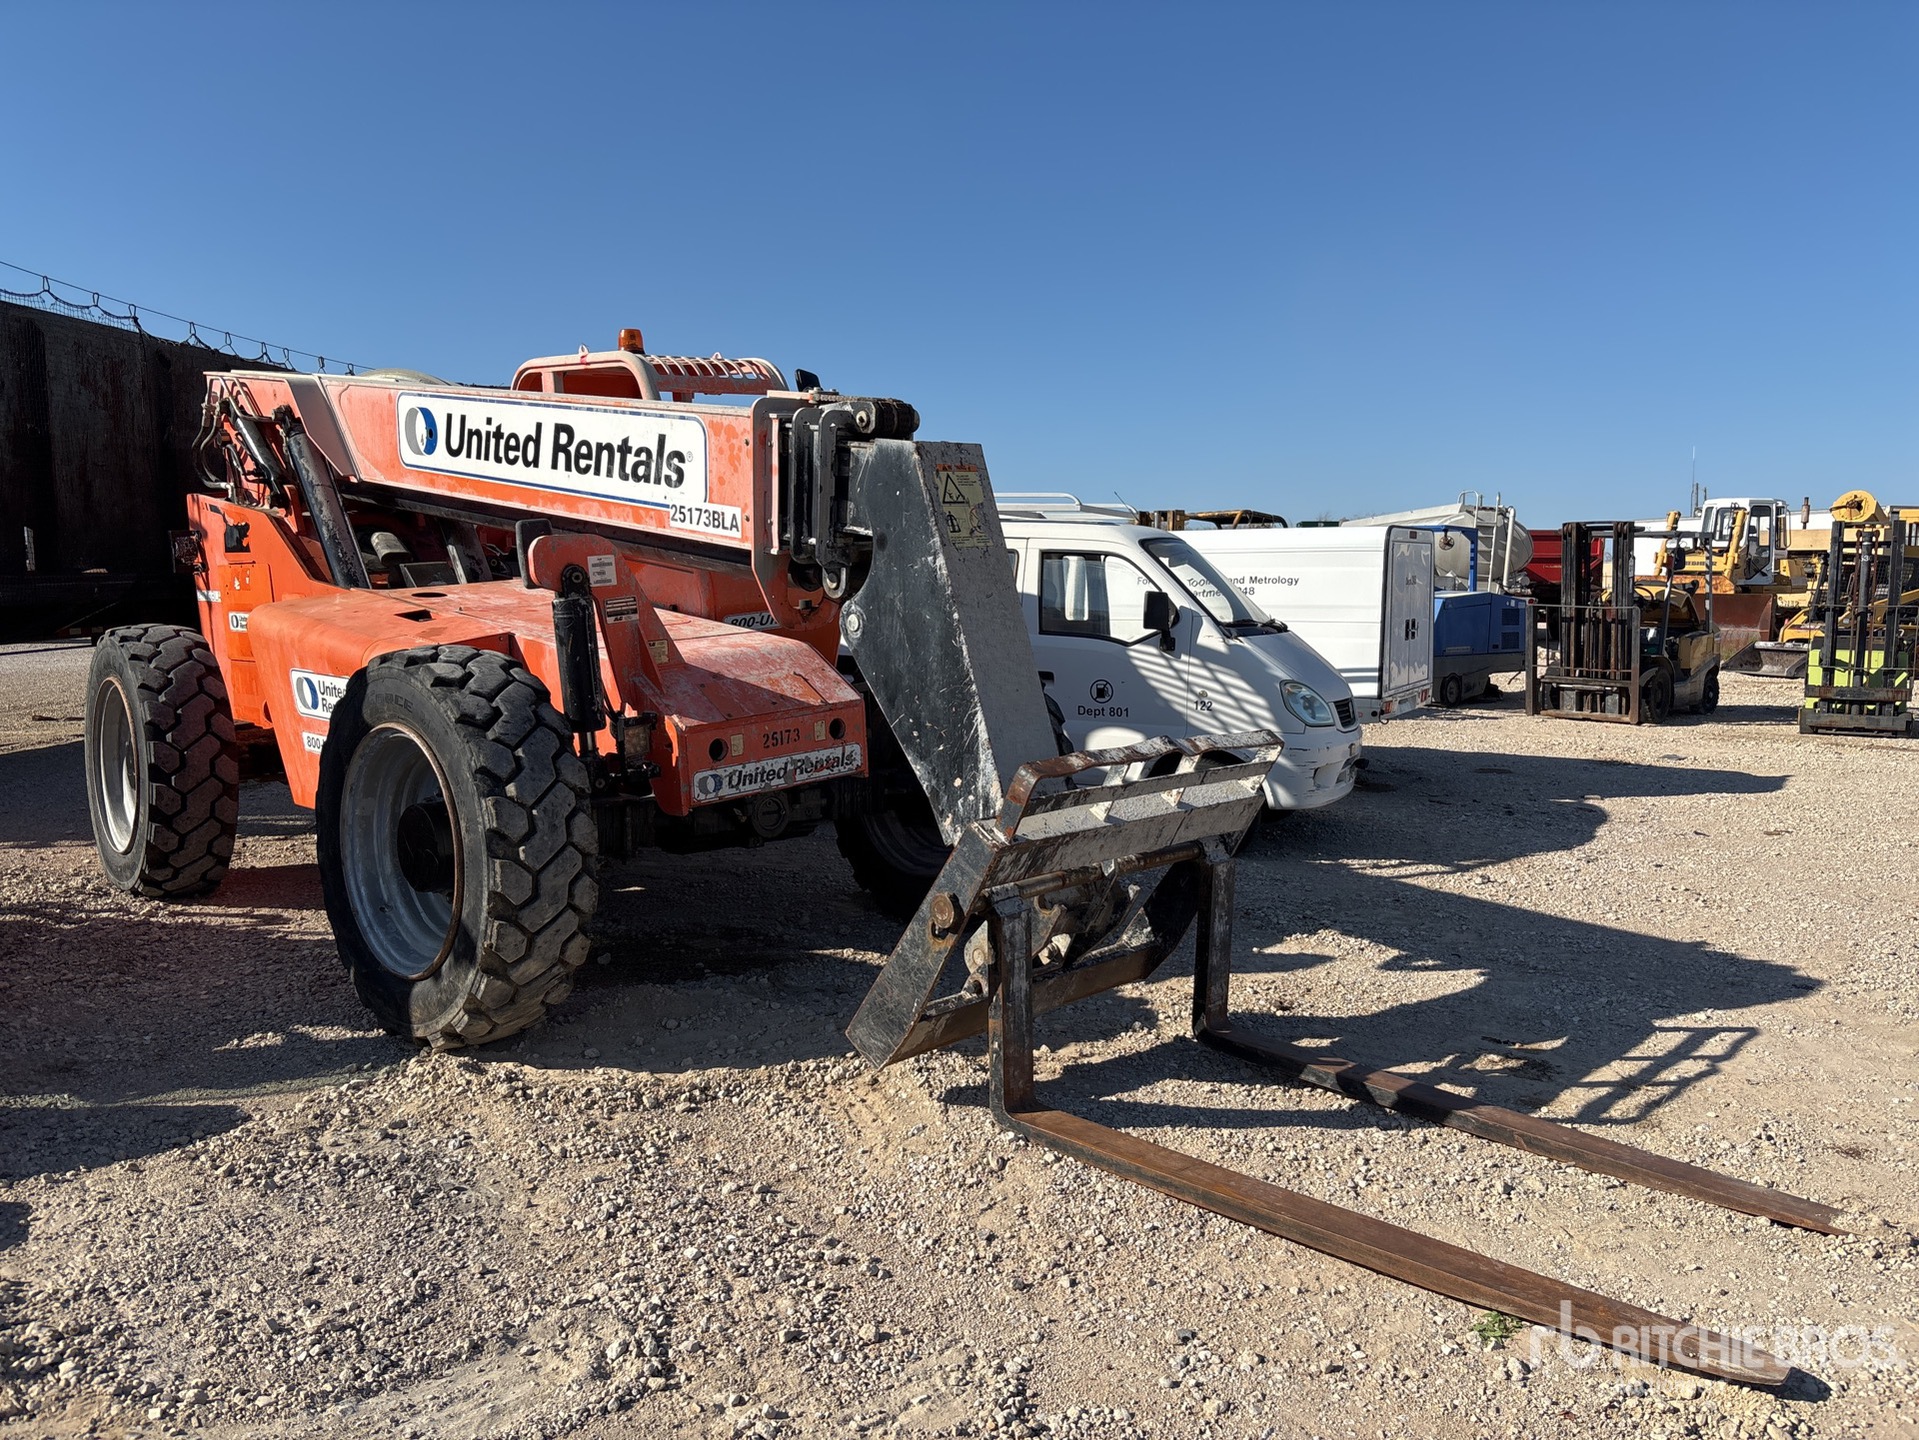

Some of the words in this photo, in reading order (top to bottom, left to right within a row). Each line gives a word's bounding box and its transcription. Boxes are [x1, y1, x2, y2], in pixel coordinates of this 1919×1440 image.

[445, 413, 542, 469] United
[551, 423, 686, 489] Rentals
[669, 503, 740, 533] 25173BLA
[1249, 575, 1300, 586] Metrology
[1077, 705, 1105, 718] Dept
[1109, 706, 1130, 718] 801
[1194, 700, 1213, 712] 122
[762, 728, 801, 749] 25173
[727, 762, 789, 790] United
[793, 750, 856, 776] Rentals
